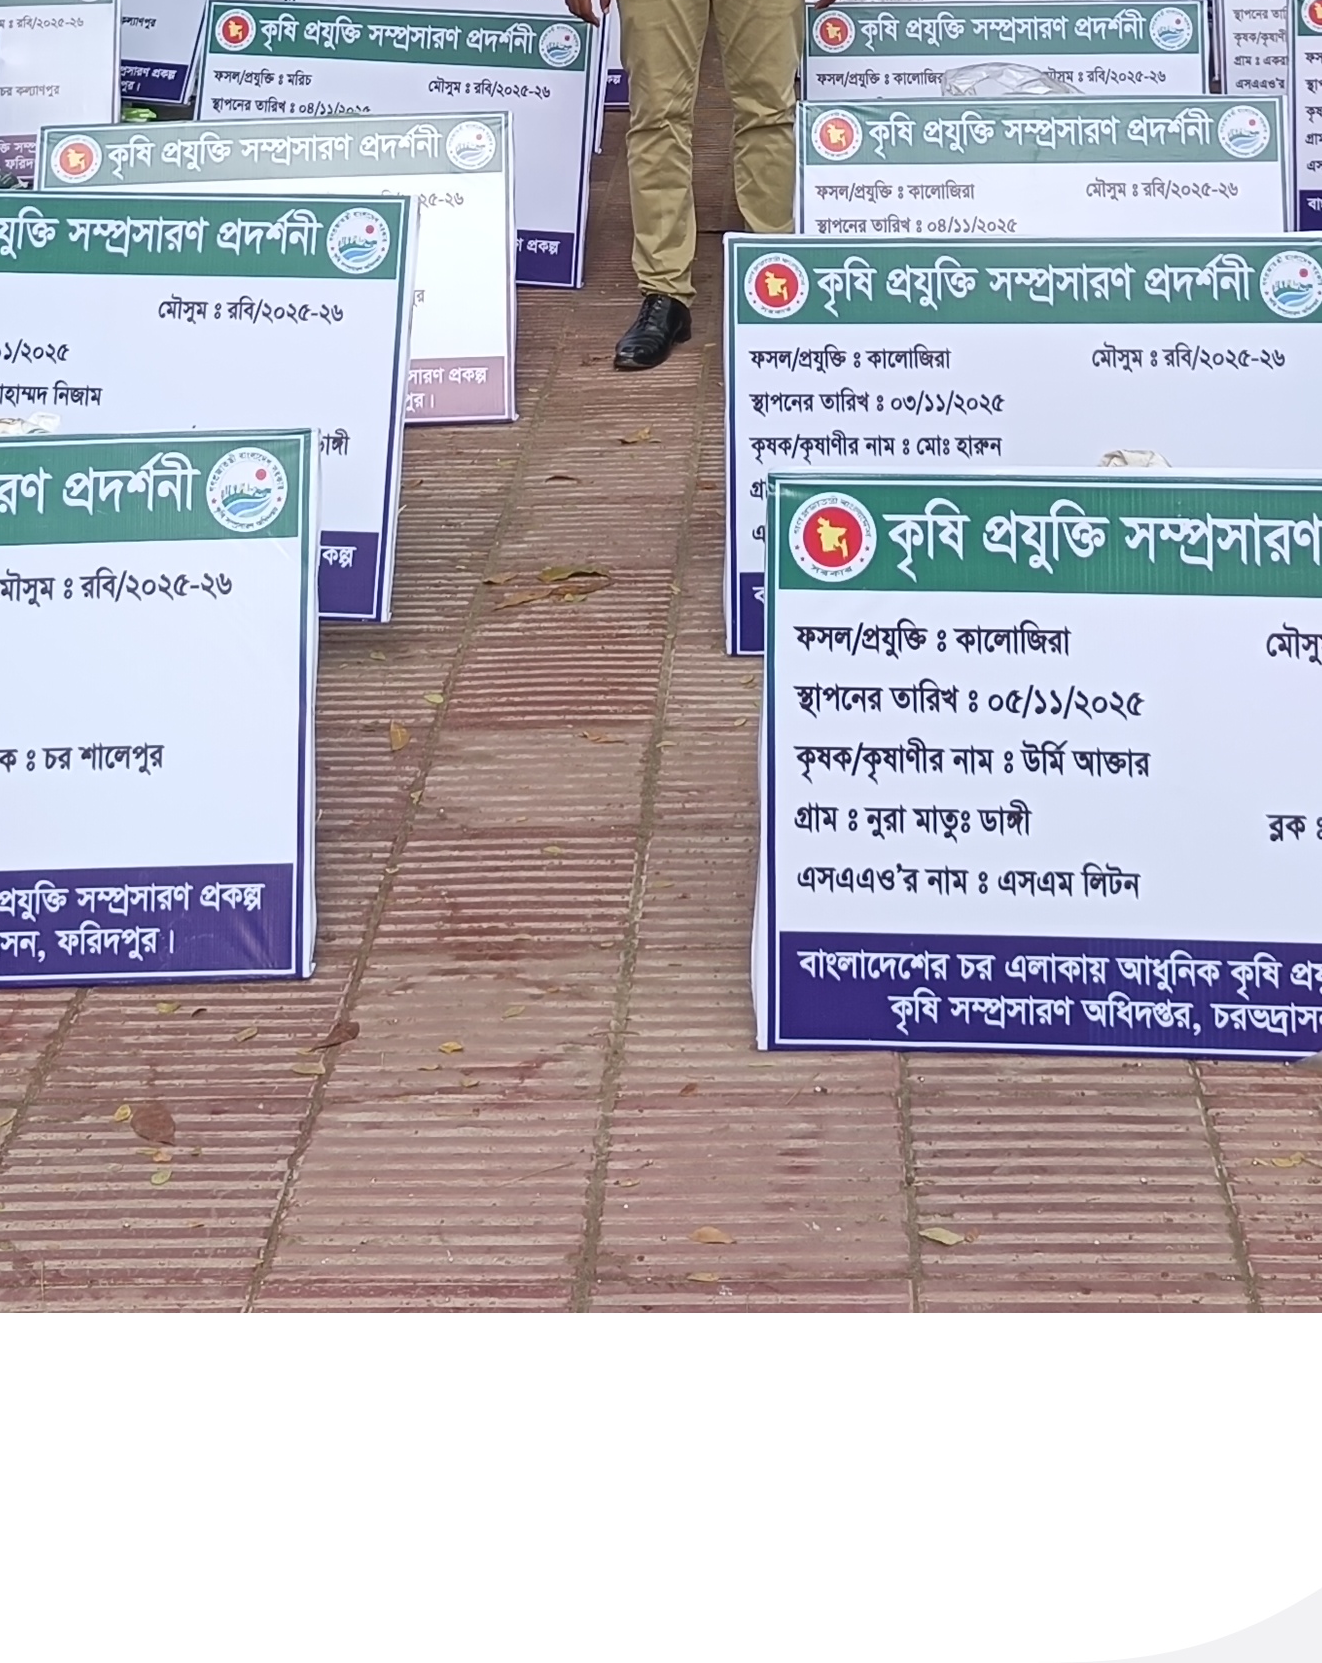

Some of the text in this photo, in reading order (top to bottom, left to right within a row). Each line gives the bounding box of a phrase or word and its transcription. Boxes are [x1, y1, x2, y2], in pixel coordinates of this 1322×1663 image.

[67, 216, 209, 257] সম্প্রসারণ
[217, 209, 323, 255] প্রদর্শনী
[813, 254, 1255, 317] কৃষি প্রযুক্তি সম্প্রসারণ প্রদর্শনী
[159, 294, 343, 324] মৌসুম রবি/২০২৫-২৬
[53, 380, 102, 406] নিজাম
[749, 430, 1002, 465] কৃষক/কৃষাণীর নাম মোঃ হারুন
[63, 452, 201, 515] প্রদর্শনী
[883, 498, 970, 582] কৃষি
[983, 499, 1110, 574] প্রযুক্তি
[80, 567, 232, 602] রবি/২০২৫-২৬
[42, 748, 73, 770] চর
[78, 743, 164, 775] শালেপুর
[794, 737, 1151, 784] কৃষক/কৃষাণীর নাম উর্মি আক্তার
[795, 803, 839, 832] গ্রাম
[864, 805, 907, 839] নুরা
[977, 799, 1032, 835] ডাঙ্গী
[1266, 815, 1306, 841] ব্লক
[925, 866, 969, 895] নাম
[998, 871, 1074, 896] এসএম
[1081, 863, 1141, 898] লিটন
[75, 882, 193, 916] সম্প্রসারণ
[200, 882, 265, 911] প্রকল্প
[888, 992, 942, 1035] কৃষি
[948, 995, 1074, 1028] সম্প্রসারণ
[1080, 995, 1201, 1035] অধিদপ্তর,
